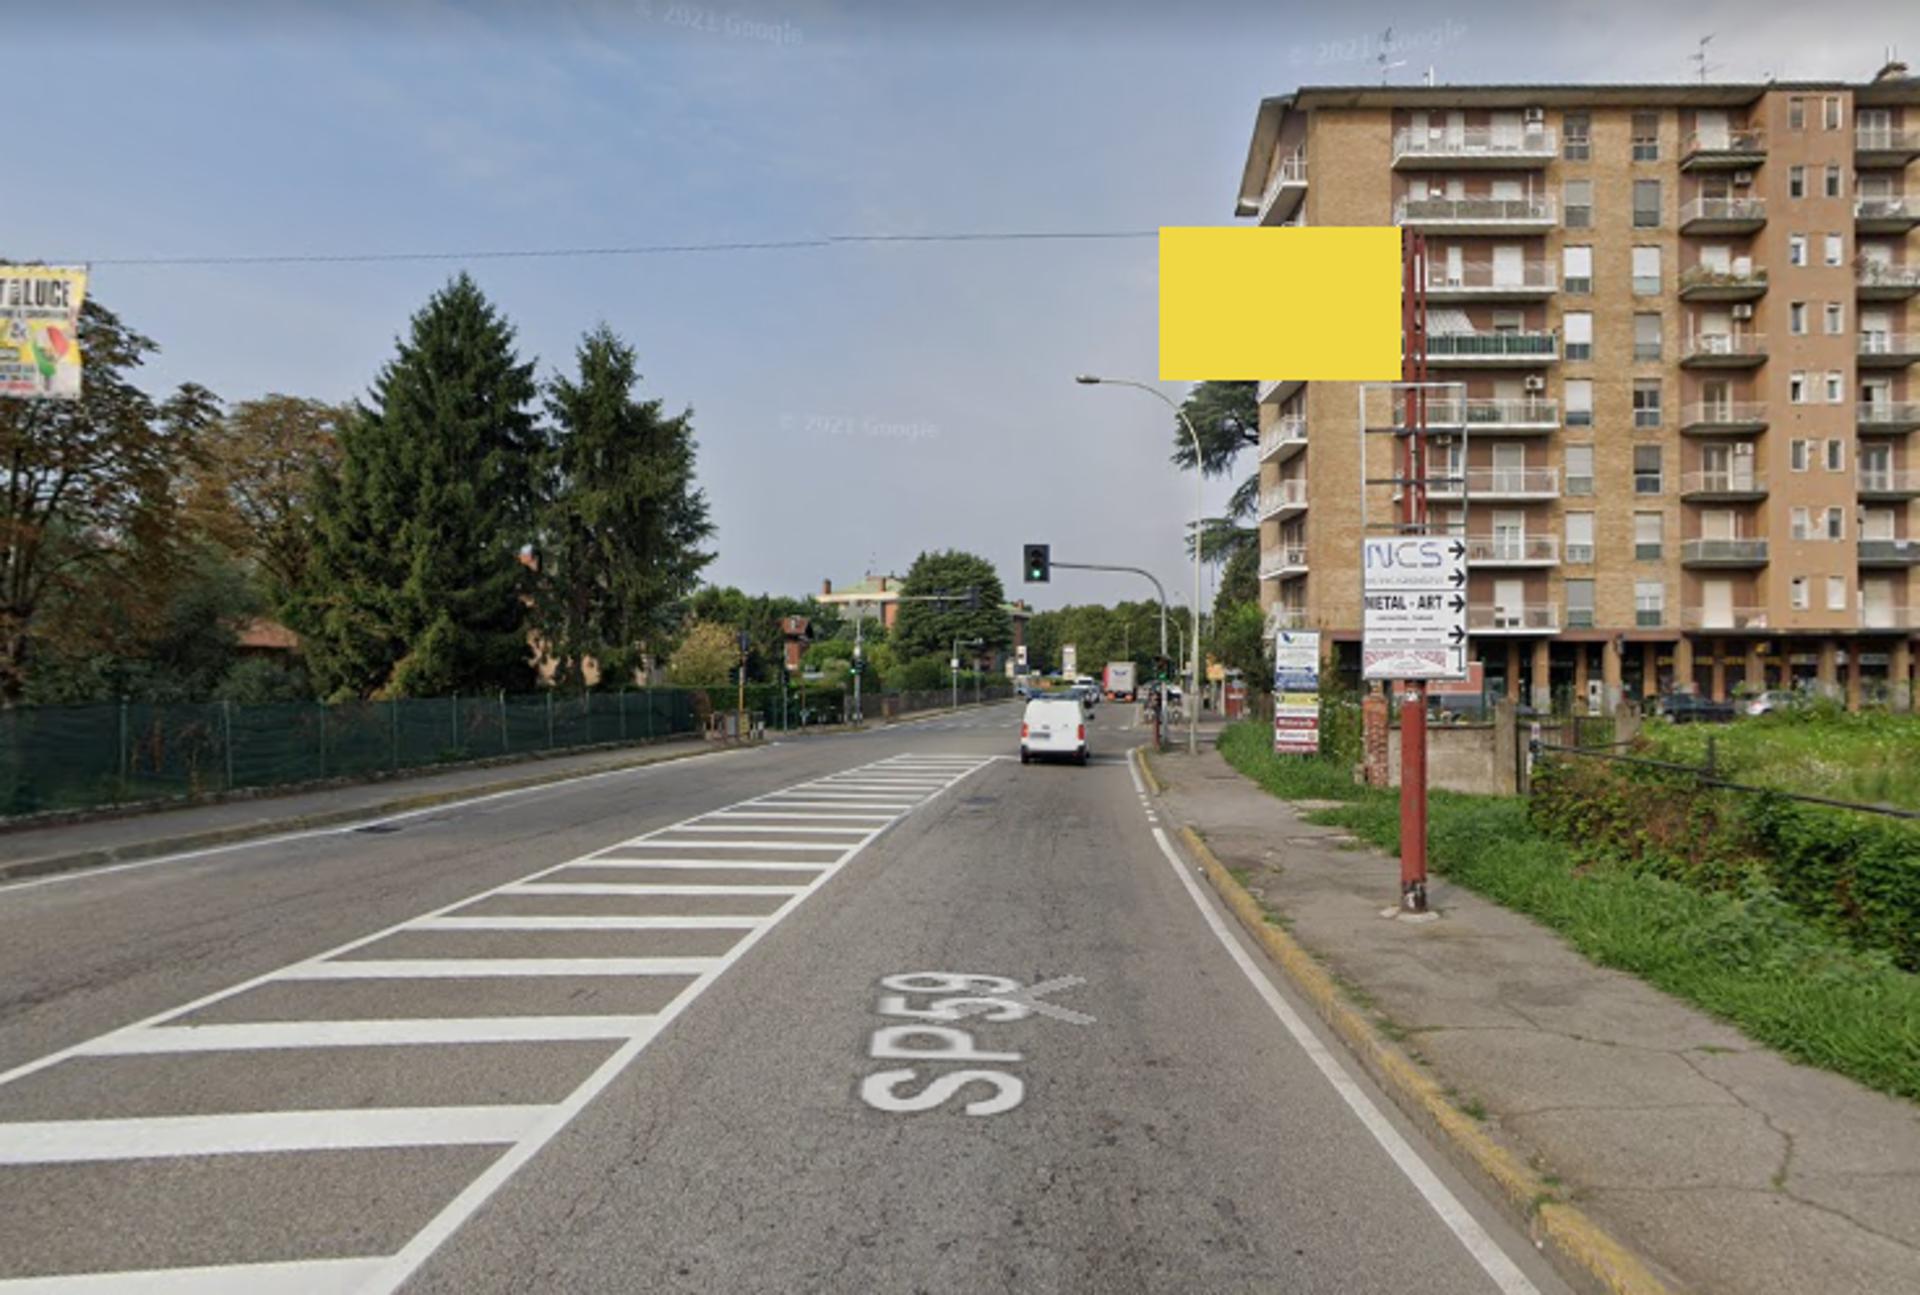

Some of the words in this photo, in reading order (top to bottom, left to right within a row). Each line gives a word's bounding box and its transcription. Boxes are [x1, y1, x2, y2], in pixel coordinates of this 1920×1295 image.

[25, 279, 70, 307] LUCE
[1367, 541, 1443, 568] NCS
[1364, 595, 1407, 611] METAL
[1417, 594, 1443, 611] ART
[862, 971, 1030, 1116] SP59
